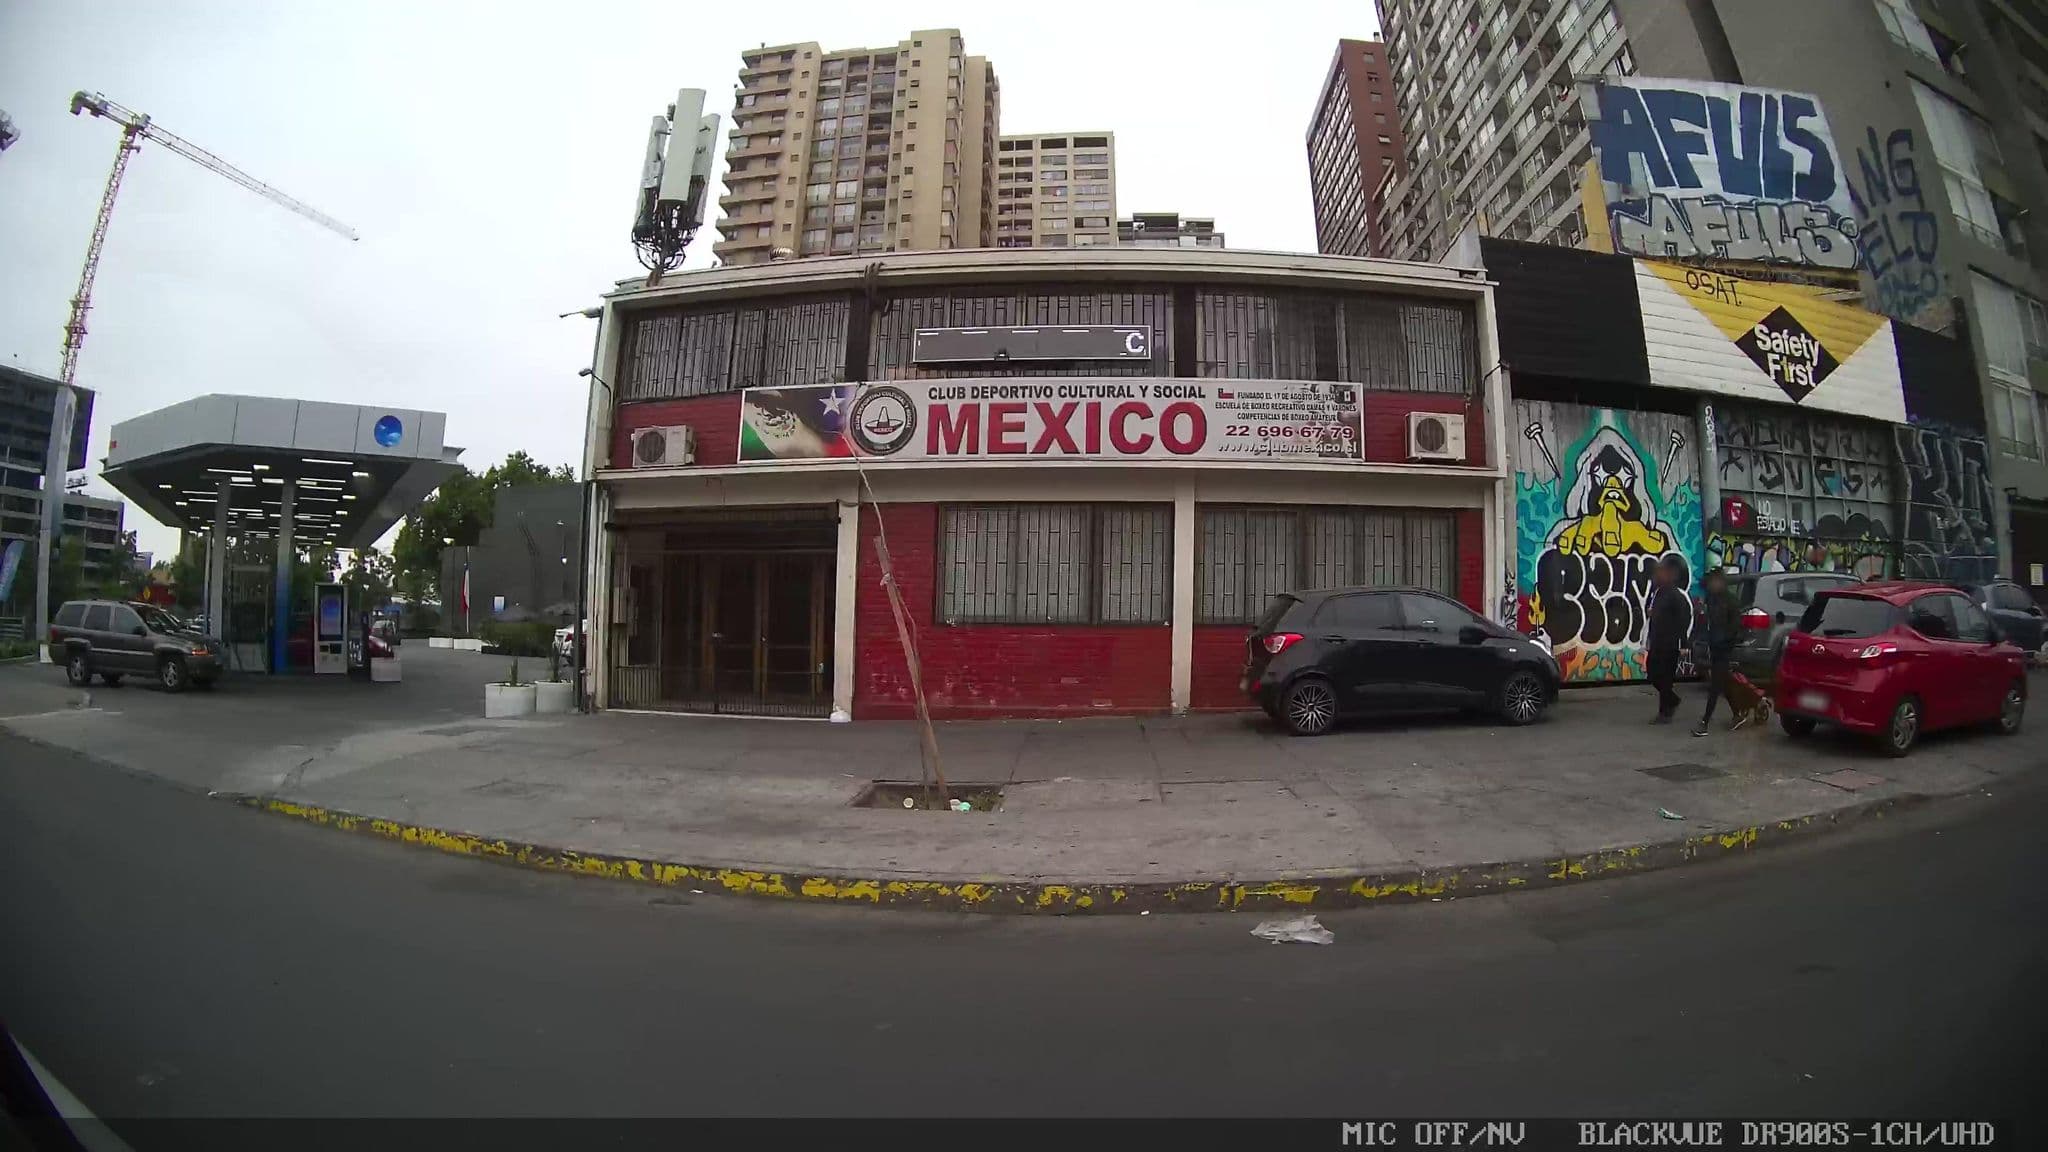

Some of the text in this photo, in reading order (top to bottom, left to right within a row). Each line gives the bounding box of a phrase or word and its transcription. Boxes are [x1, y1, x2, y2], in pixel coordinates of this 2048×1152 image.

[1125, 332, 1144, 353] C
[1754, 324, 1820, 366] Safety
[928, 385, 1206, 400] CLUB DEPORTIVO CULTURAL Y SOCIAL
[1237, 391, 1264, 399] FUNDADO
[1282, 392, 1289, 400] DE
[1290, 392, 1312, 400] AGOSTO
[1215, 401, 1241, 409] ESCUELA
[1243, 402, 1250, 410] DE
[1251, 402, 1270, 410] BOXEO
[1271, 403, 1305, 411] RECREATIVO
[1306, 403, 1325, 411] DAMAS
[1331, 404, 1356, 412] VARONES
[1237, 412, 1337, 422] COMPETENCIAS DE BOXEO AMATEUR
[926, 401, 1208, 456] MEXICO
[1225, 425, 1250, 436] 22
